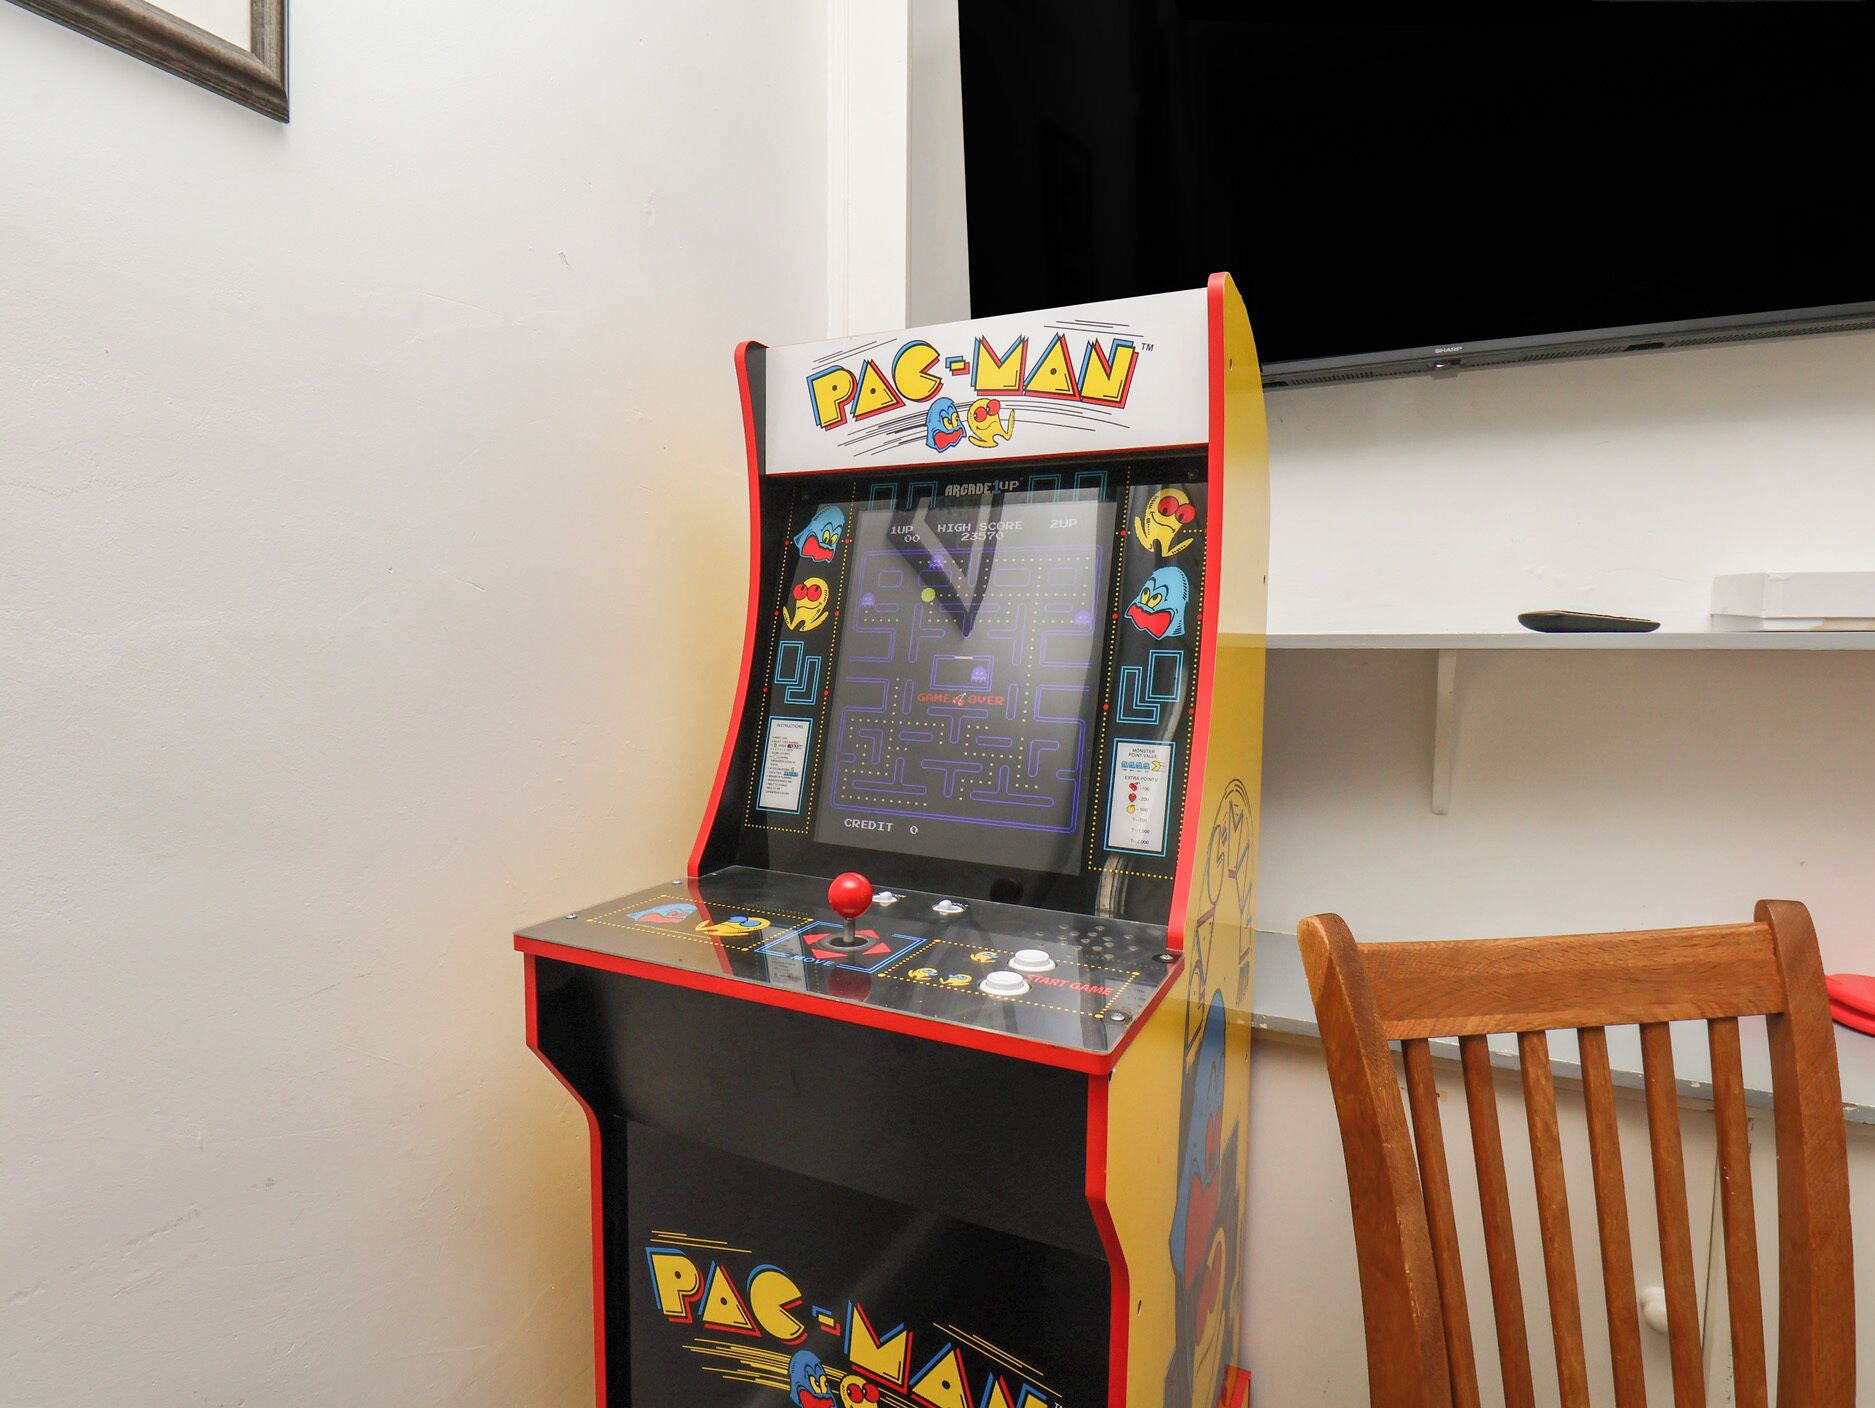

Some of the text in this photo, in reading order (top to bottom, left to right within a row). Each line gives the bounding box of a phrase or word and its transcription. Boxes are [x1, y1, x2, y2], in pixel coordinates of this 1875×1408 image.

[1434, 346, 1462, 354] SHARP
[805, 333, 1139, 431] PAC-MAN
[937, 520, 1023, 533] HIGH SCORE
[1049, 518, 1078, 529] 2UP
[890, 525, 914, 535] 1UP
[961, 531, 1004, 541] 23570
[904, 534, 920, 543] 00
[917, 693, 1004, 706] GAME OVER
[844, 818, 893, 832] CREDIT
[1026, 974, 1115, 996] START GAME
